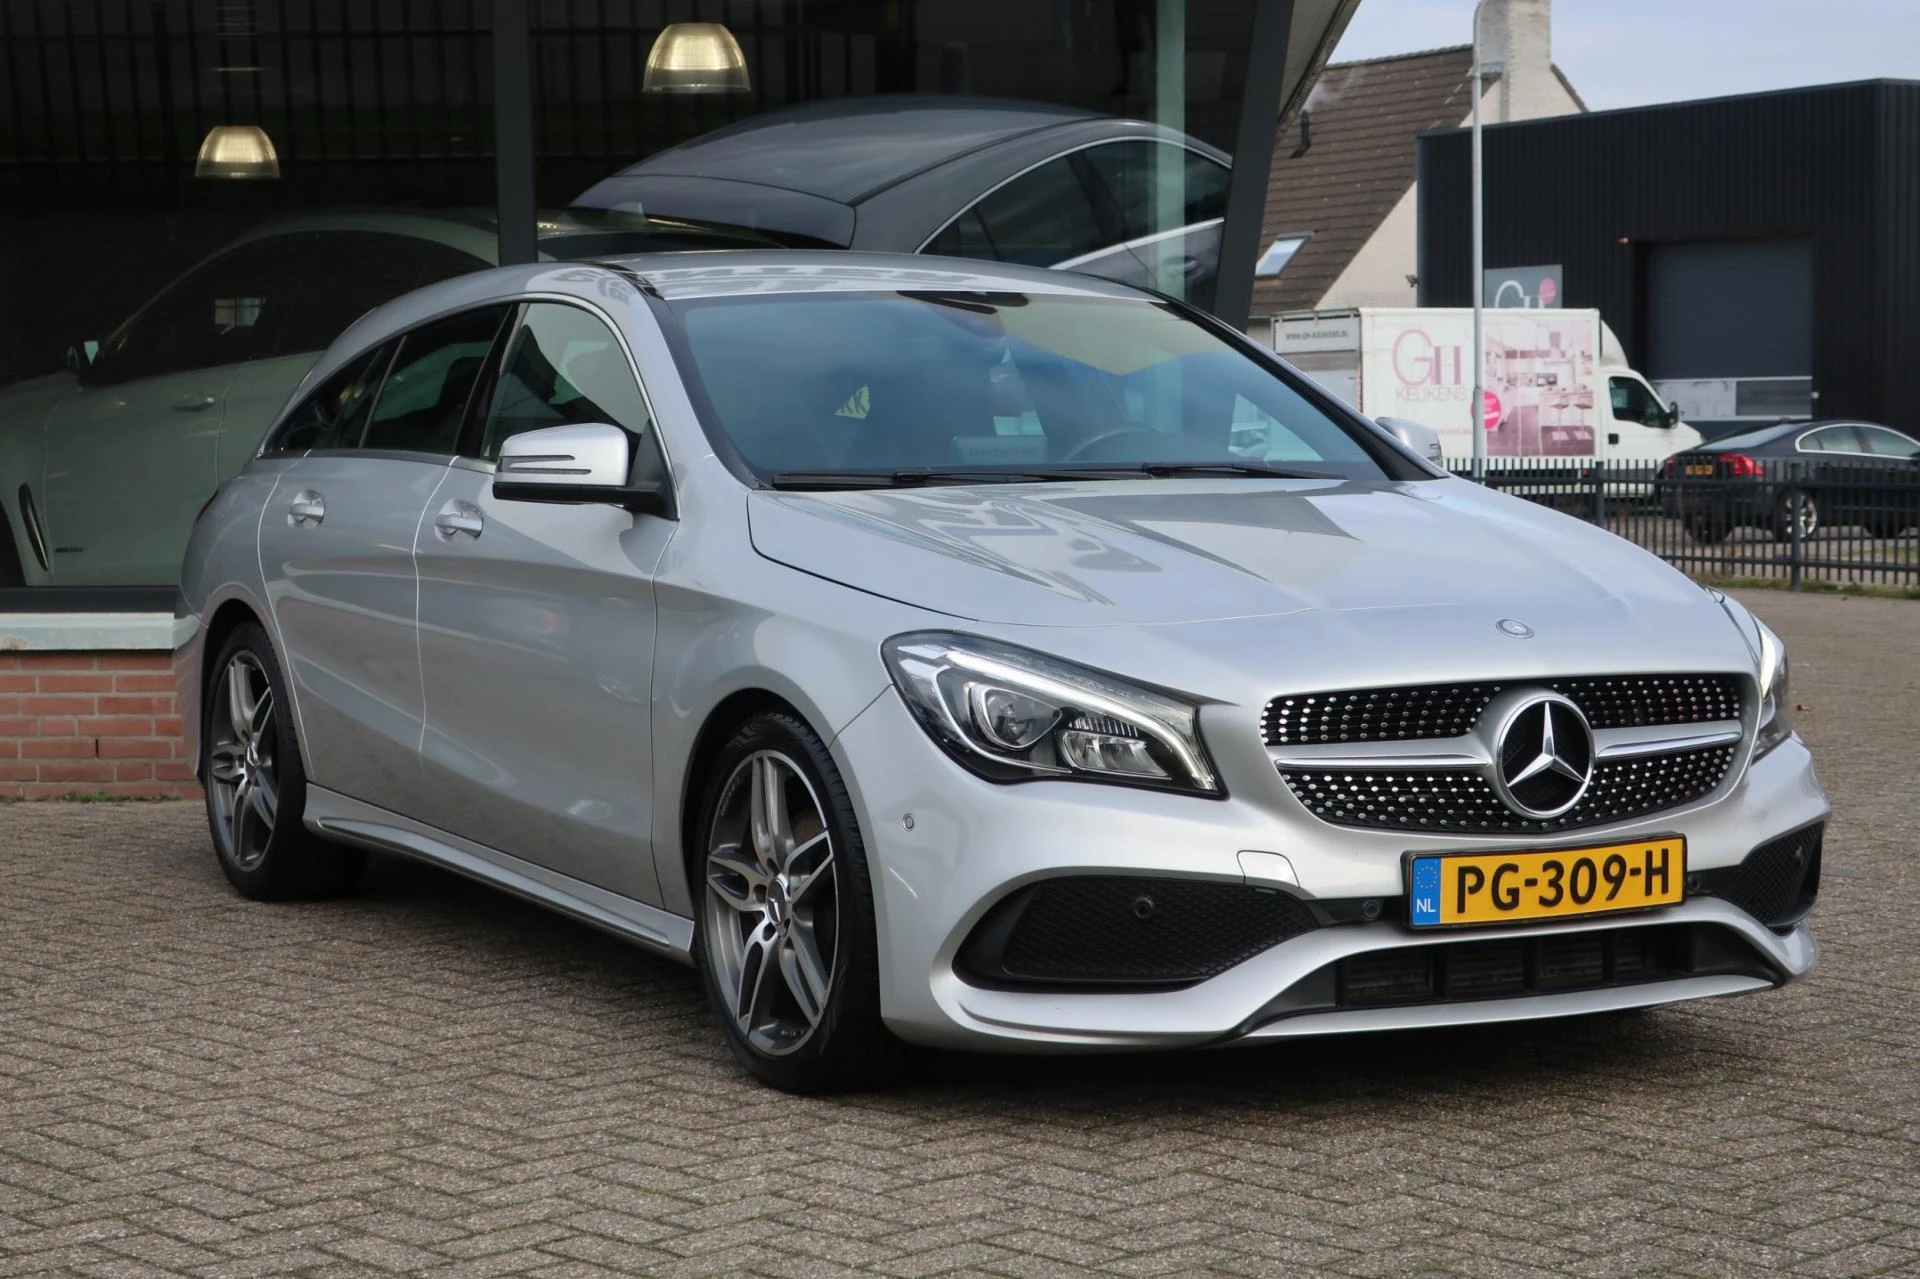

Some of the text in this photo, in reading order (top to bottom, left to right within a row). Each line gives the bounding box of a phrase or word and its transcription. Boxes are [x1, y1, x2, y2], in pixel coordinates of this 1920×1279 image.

[1395, 386, 1468, 402] KEUKENS
[1456, 847, 1670, 914] PG-309-H
[1416, 898, 1436, 914] NL
